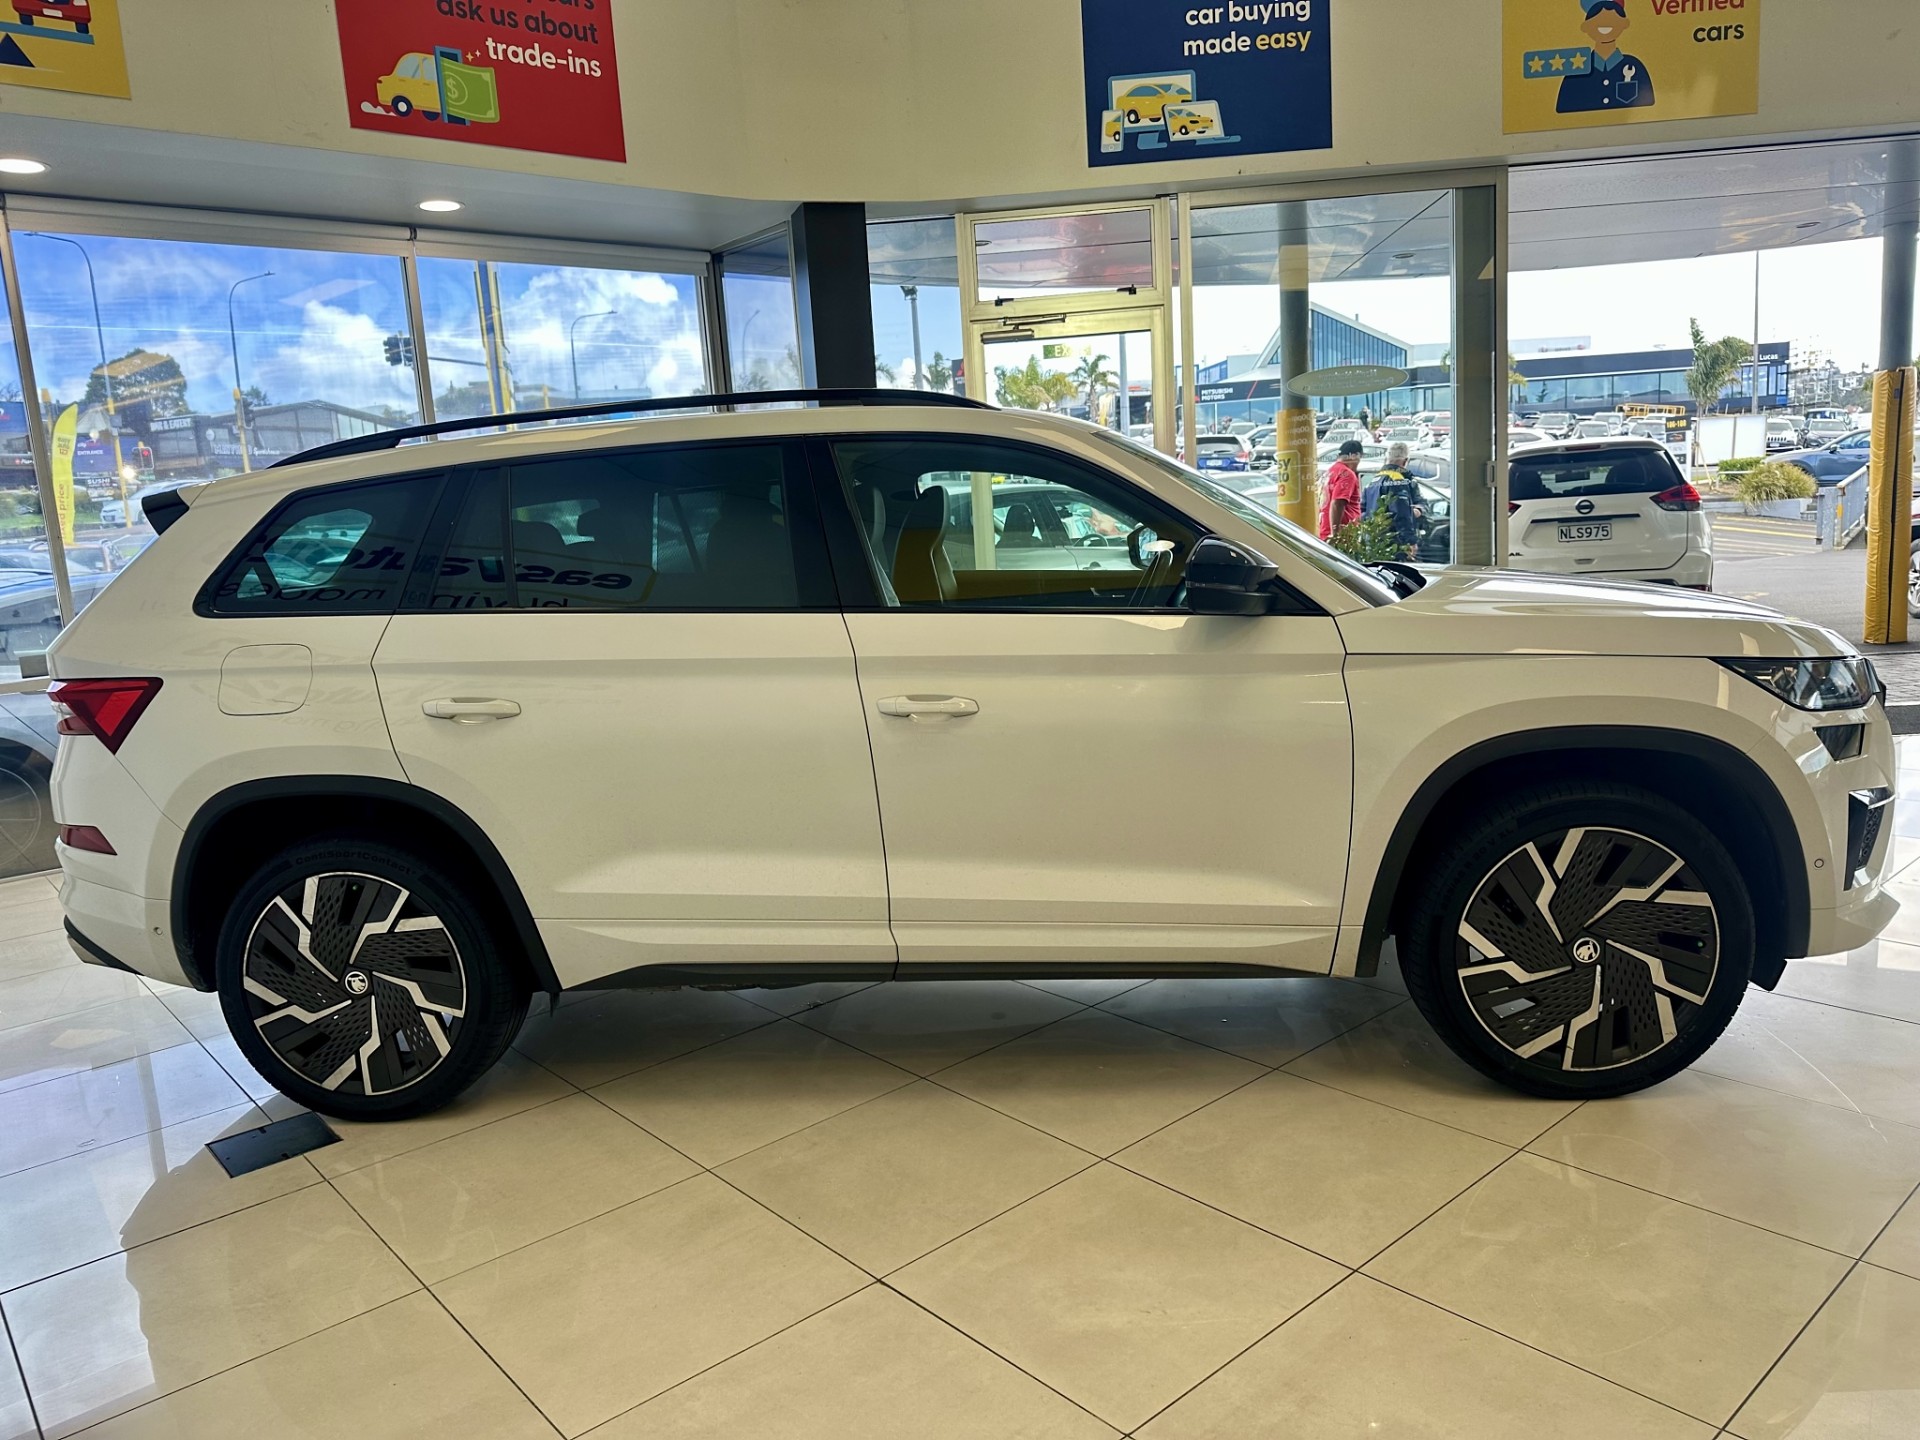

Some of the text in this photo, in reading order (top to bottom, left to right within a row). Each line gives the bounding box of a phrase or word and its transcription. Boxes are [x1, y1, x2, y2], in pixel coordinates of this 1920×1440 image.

[436, 0, 599, 44] ask us about
[1185, 0, 1311, 26] car buying
[1183, 31, 1312, 57] made easy
[1693, 23, 1745, 43] cars
[485, 37, 602, 78] trade-ins
[1759, 353, 1779, 361] Lucas
[1201, 387, 1234, 396] MITSUBISHI
[57, 483, 67, 511] price
[1560, 525, 1609, 540] NLS975
